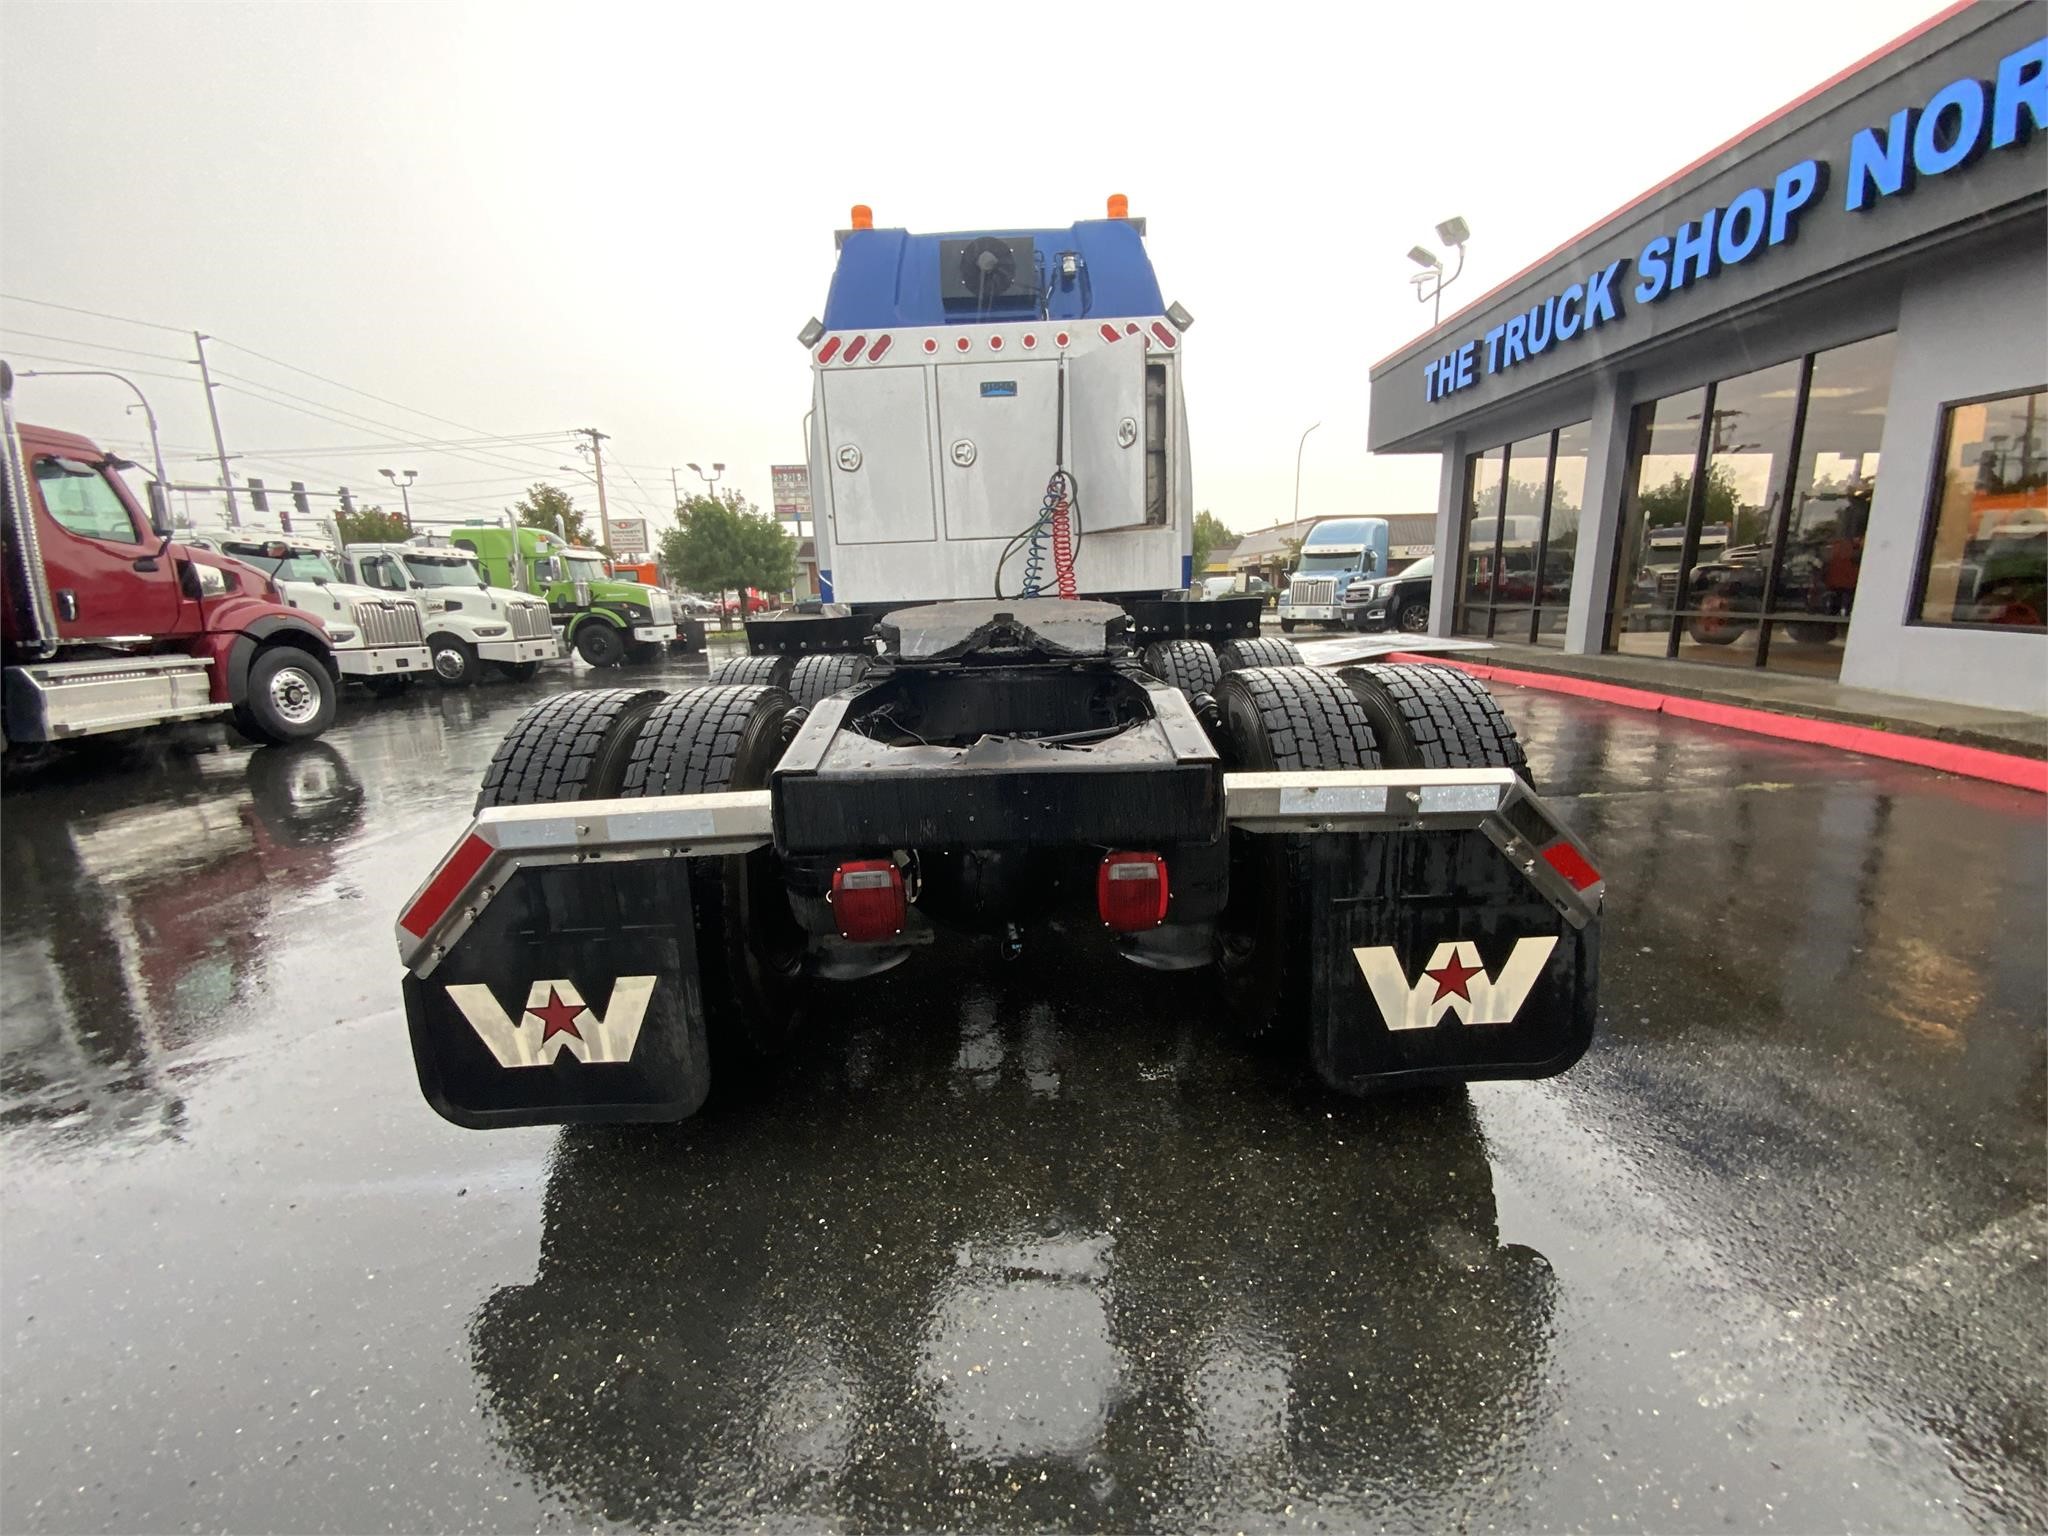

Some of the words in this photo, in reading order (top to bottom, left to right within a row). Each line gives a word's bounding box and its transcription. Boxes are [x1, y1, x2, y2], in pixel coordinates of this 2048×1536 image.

[1424, 341, 1476, 402] THE
[1485, 260, 1623, 375] TRUCK
[1636, 160, 1818, 304] SHOP
